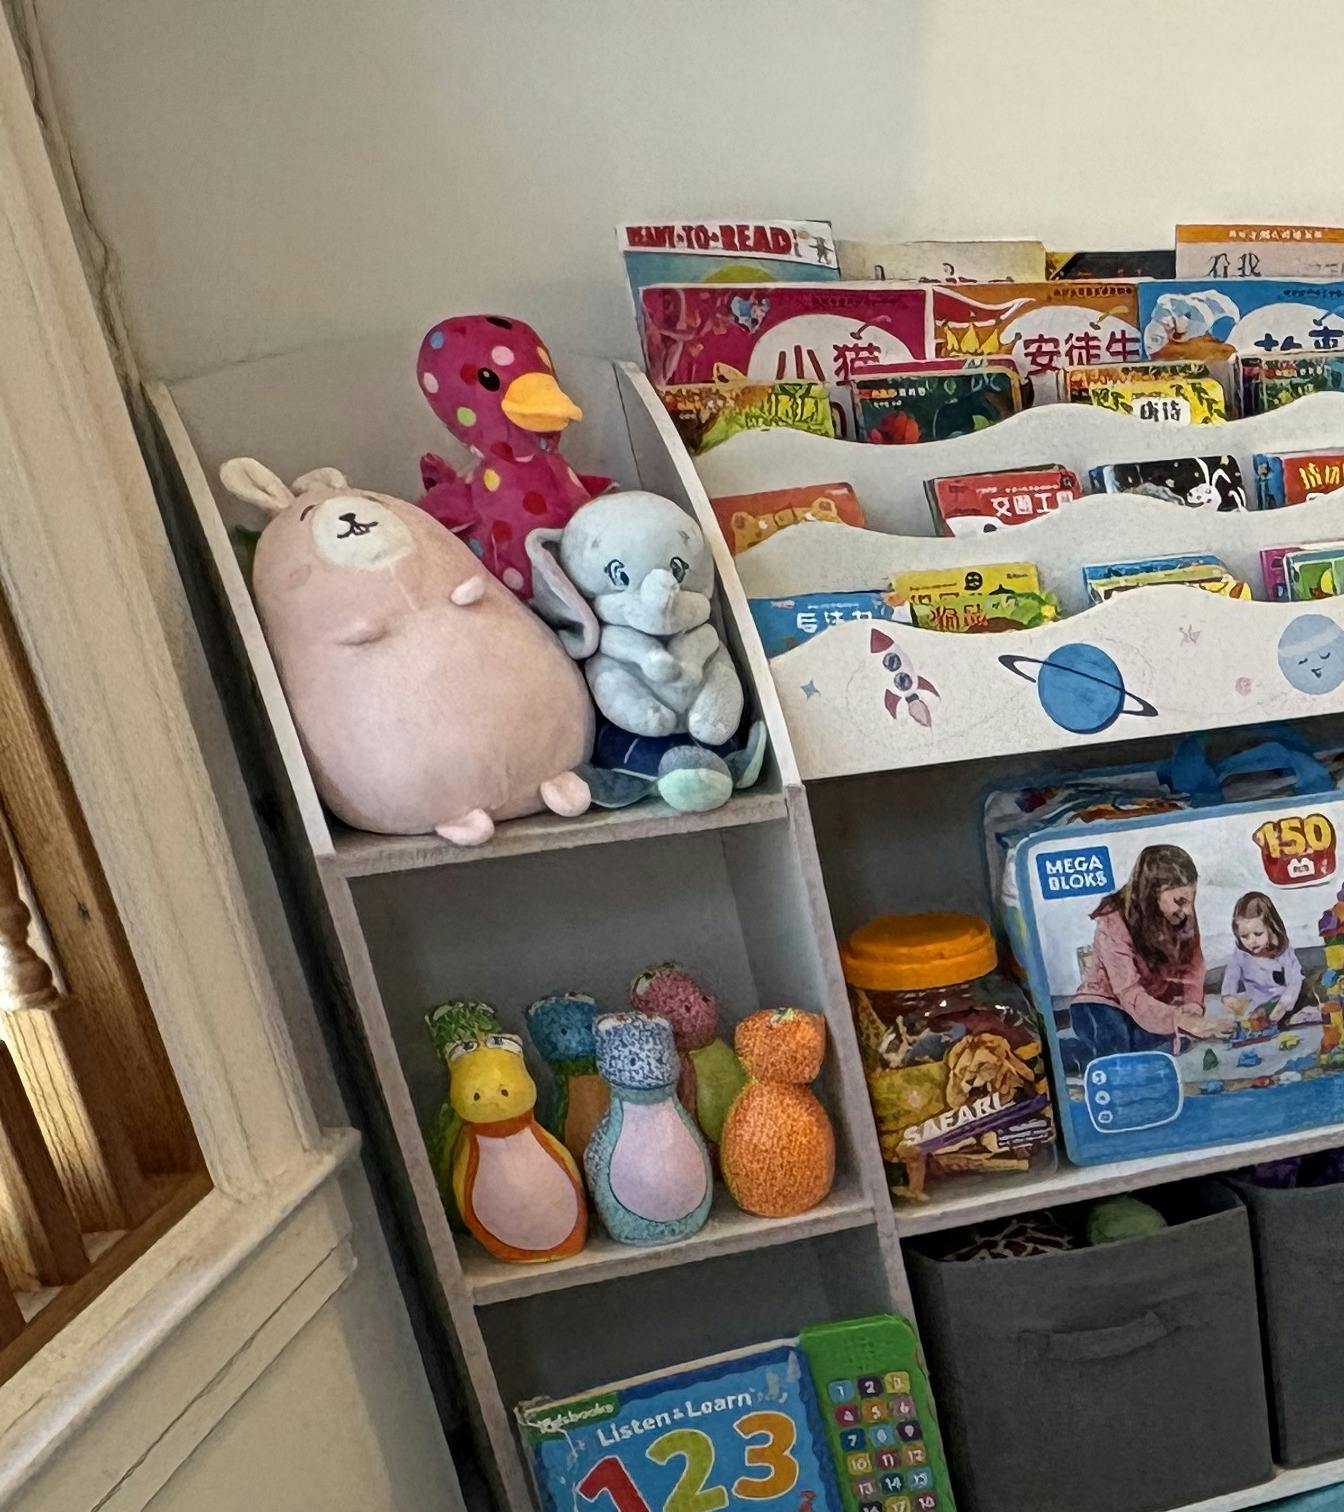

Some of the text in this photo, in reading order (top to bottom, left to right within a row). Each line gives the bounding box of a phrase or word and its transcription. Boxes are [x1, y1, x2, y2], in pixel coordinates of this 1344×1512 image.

[1256, 816, 1332, 858] 150
[1045, 855, 1103, 874] MEGA
[1048, 871, 1107, 890] BLOKS
[597, 1411, 671, 1447] Listen
[685, 1392, 752, 1417] Learn
